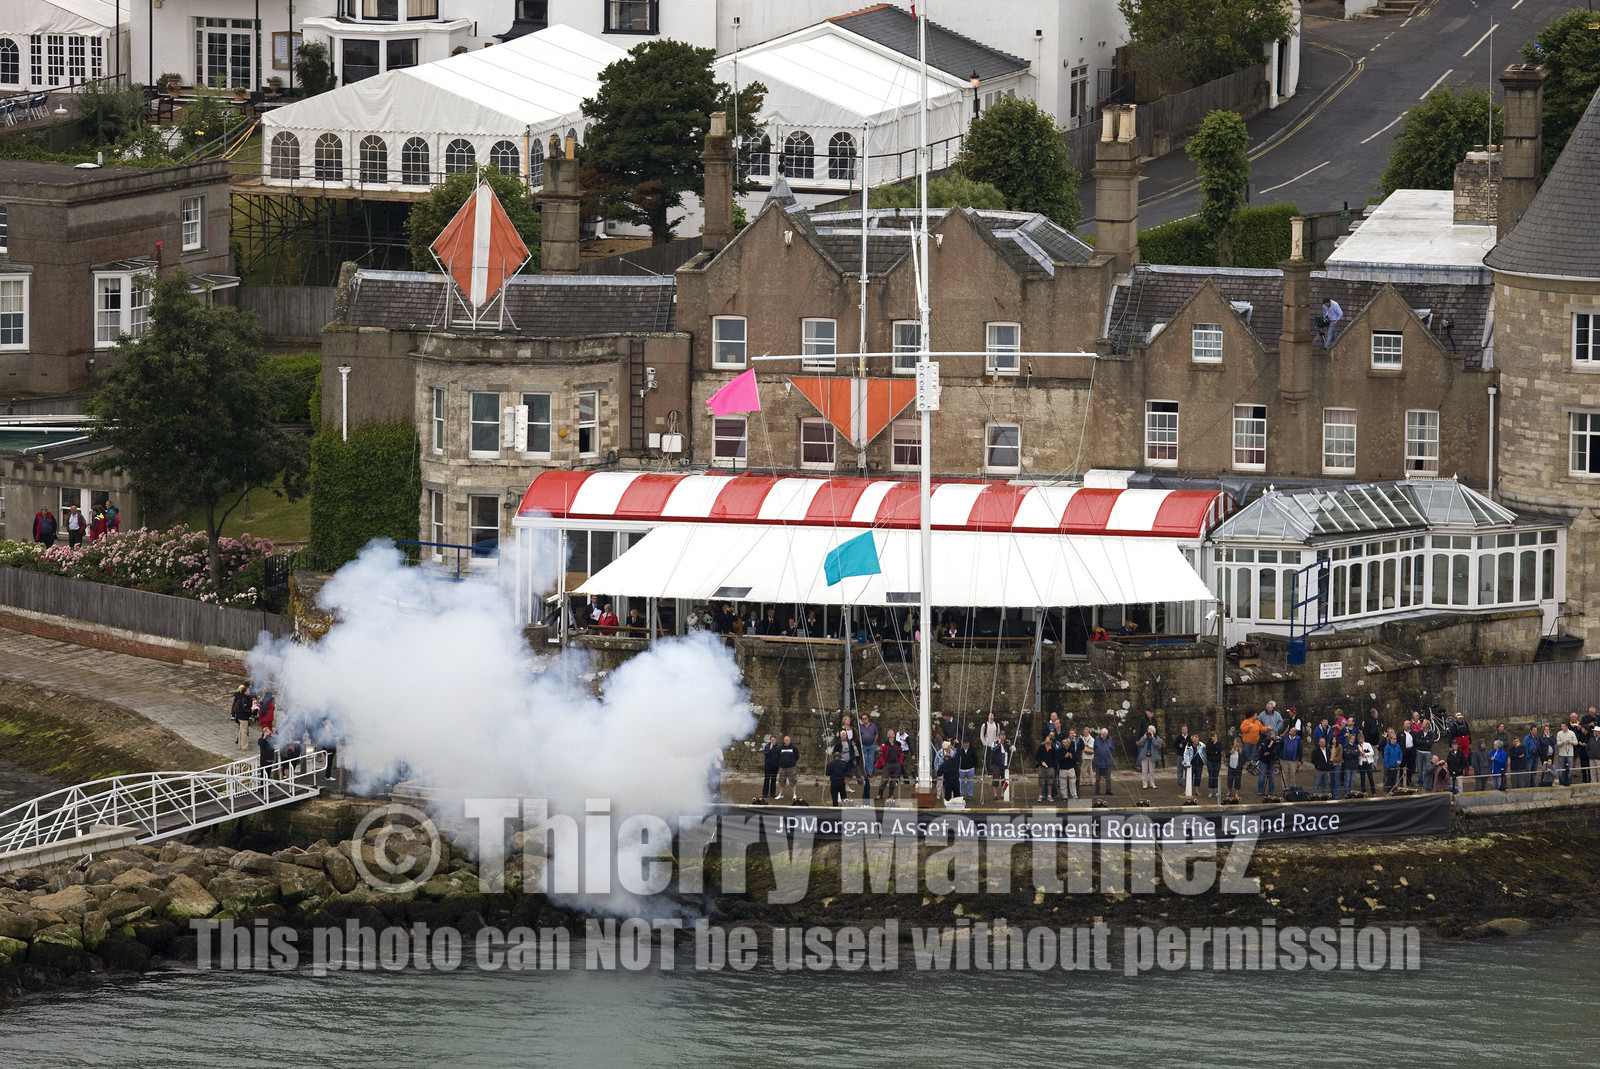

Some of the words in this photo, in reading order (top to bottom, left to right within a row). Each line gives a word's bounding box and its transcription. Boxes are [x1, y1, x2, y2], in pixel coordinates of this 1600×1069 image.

[775, 815, 883, 837] JPMorgan
[891, 818, 949, 836] Asset
[957, 818, 1100, 839] Management
[1106, 817, 1175, 838] Round
[1181, 816, 1216, 837] the
[1223, 812, 1285, 835] Island
[1291, 812, 1341, 832] Race
